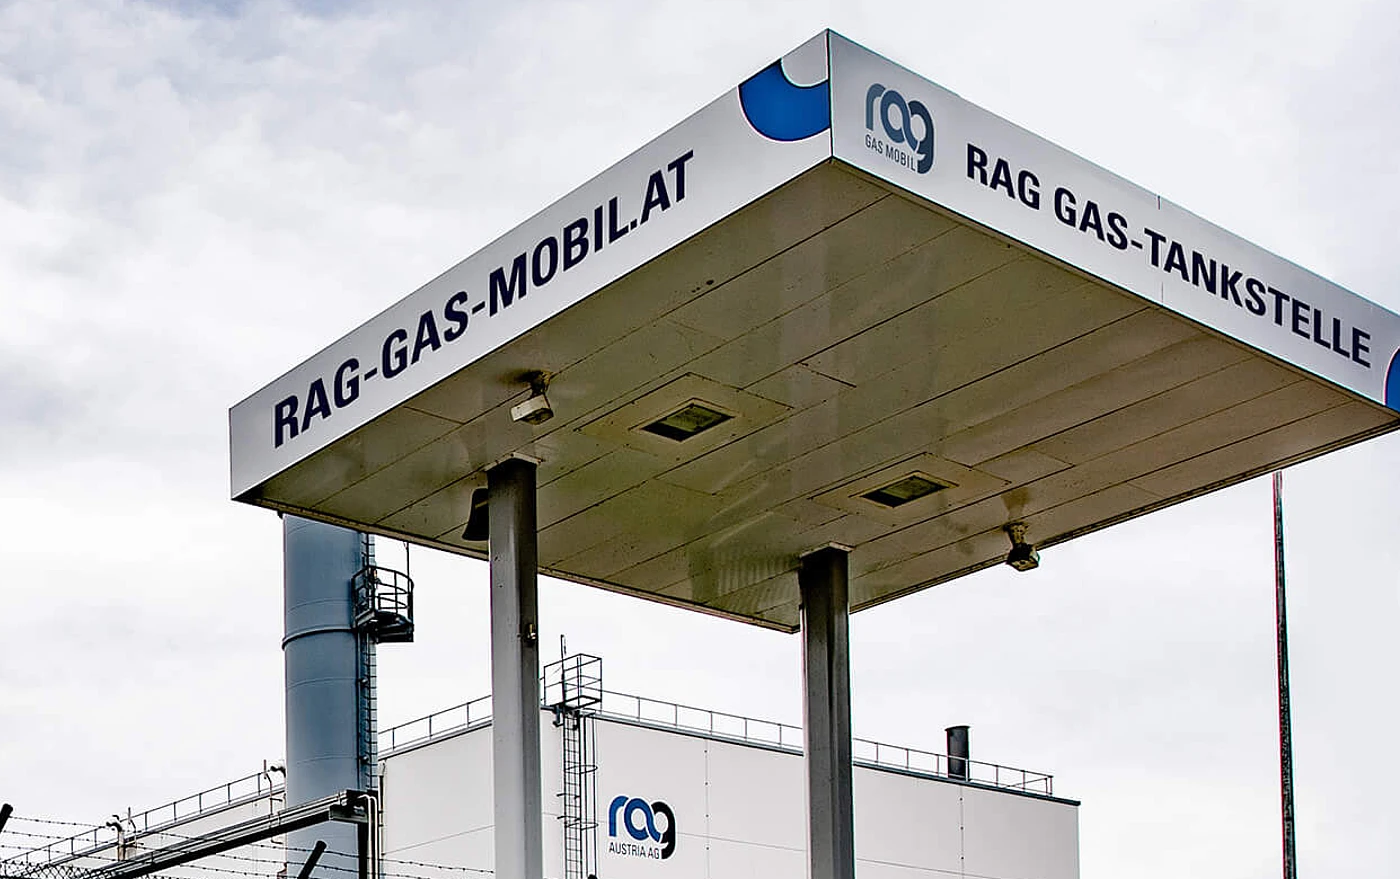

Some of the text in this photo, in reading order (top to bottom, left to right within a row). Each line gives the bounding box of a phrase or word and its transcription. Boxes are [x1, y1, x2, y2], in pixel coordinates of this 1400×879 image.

[864, 133, 917, 172] GAS MOBIL
[273, 148, 695, 449] RAG-GAS-MOBIL.AT
[966, 142, 1372, 370] RAG GAS-TANKSTELLE
[608, 842, 660, 860] AUSTRIA AG
